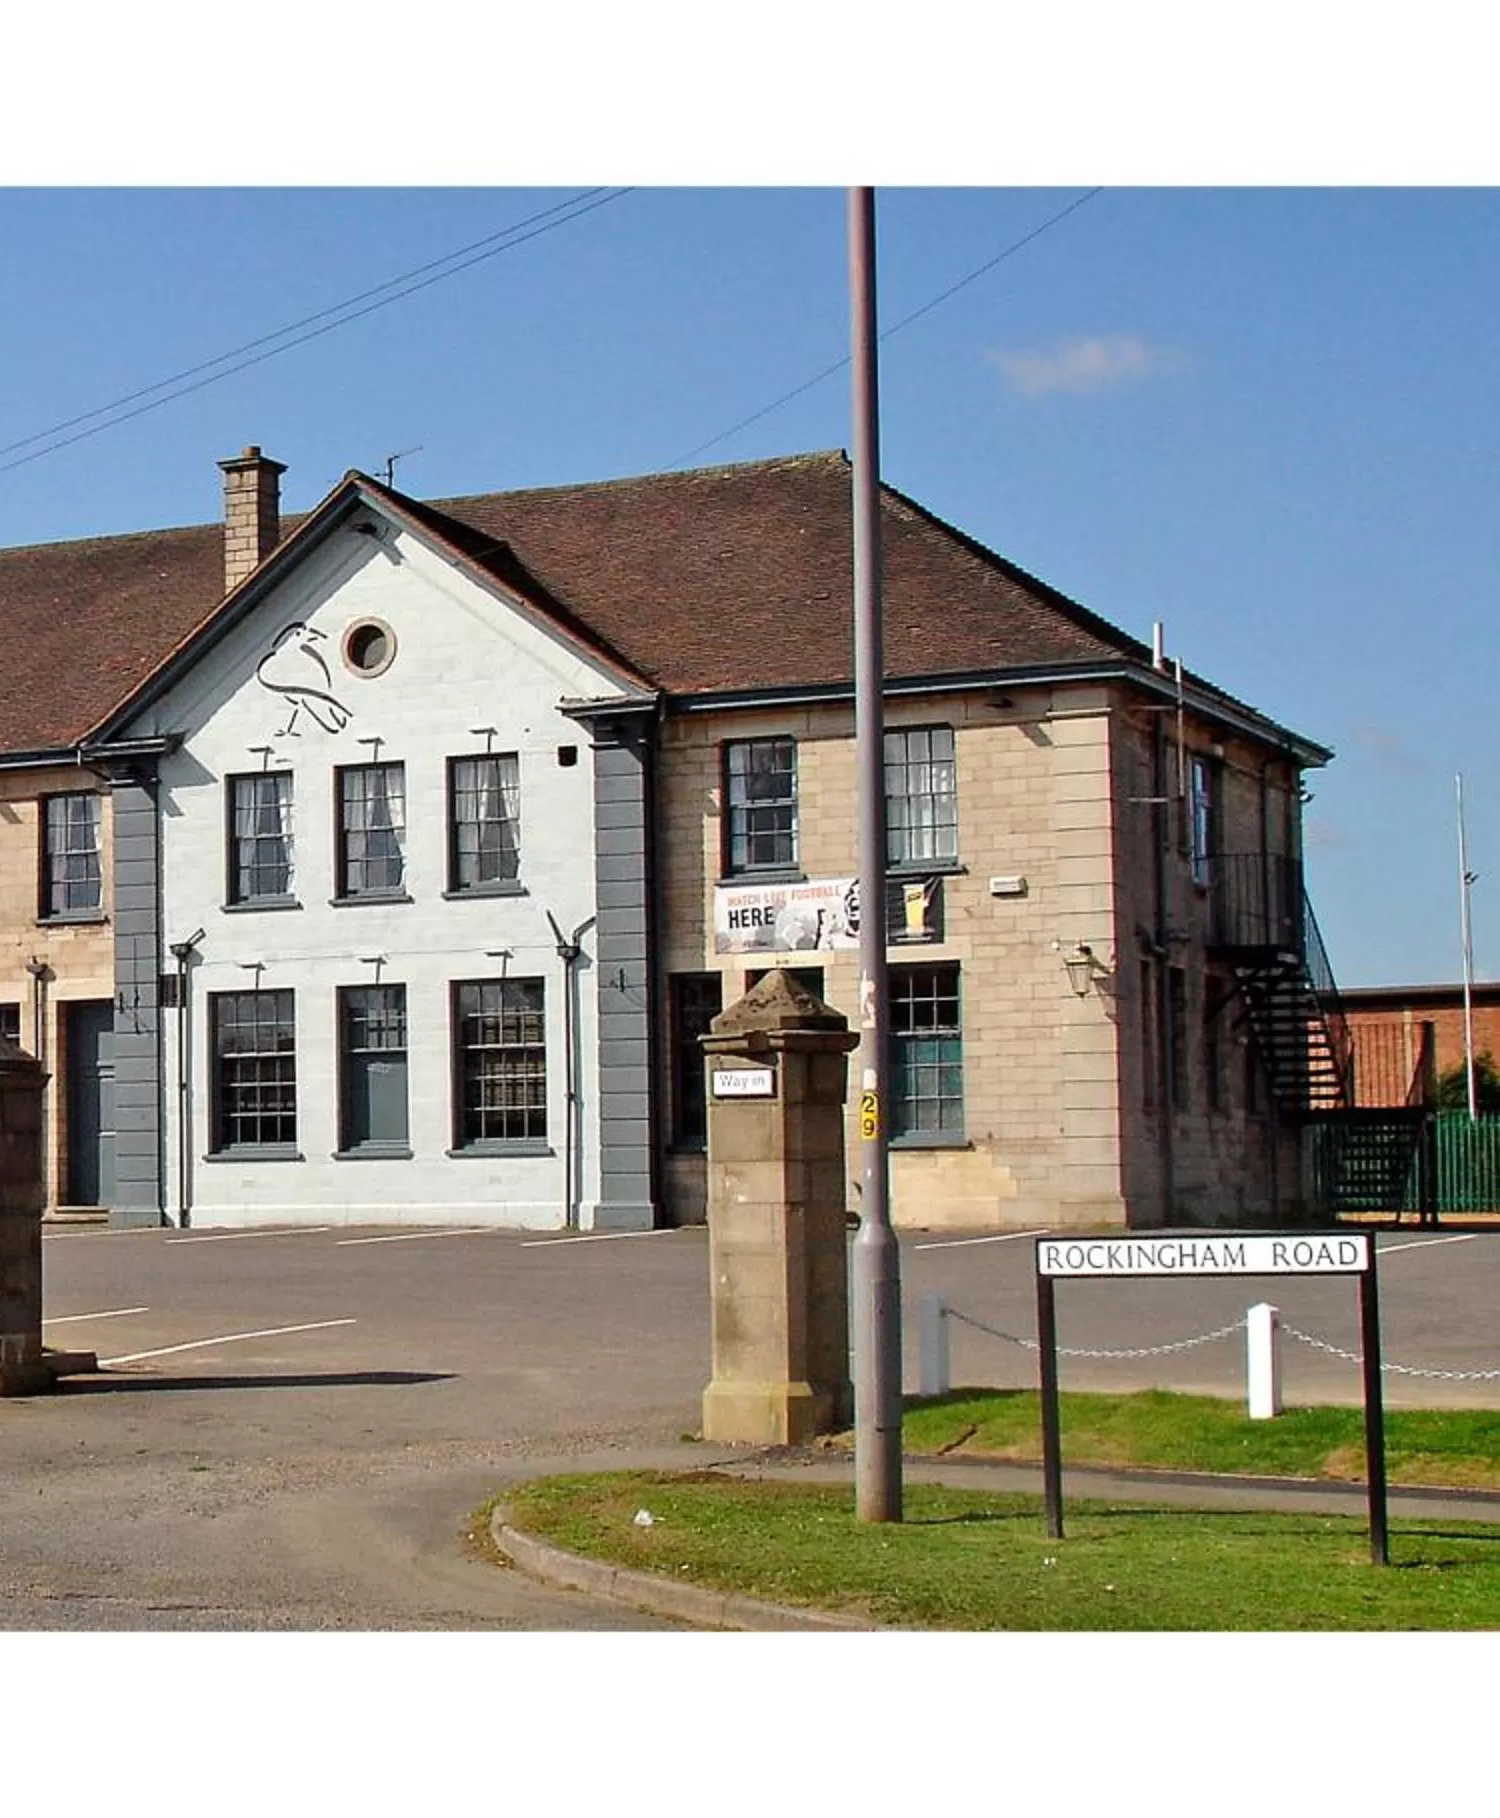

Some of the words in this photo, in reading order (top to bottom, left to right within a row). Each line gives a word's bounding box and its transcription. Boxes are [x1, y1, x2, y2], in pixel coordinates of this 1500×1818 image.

[728, 906, 775, 929] HERE
[719, 1074, 749, 1090] Way
[1046, 1243, 1246, 1269] ROCKINGHAM
[1272, 1241, 1358, 1266] ROAD
